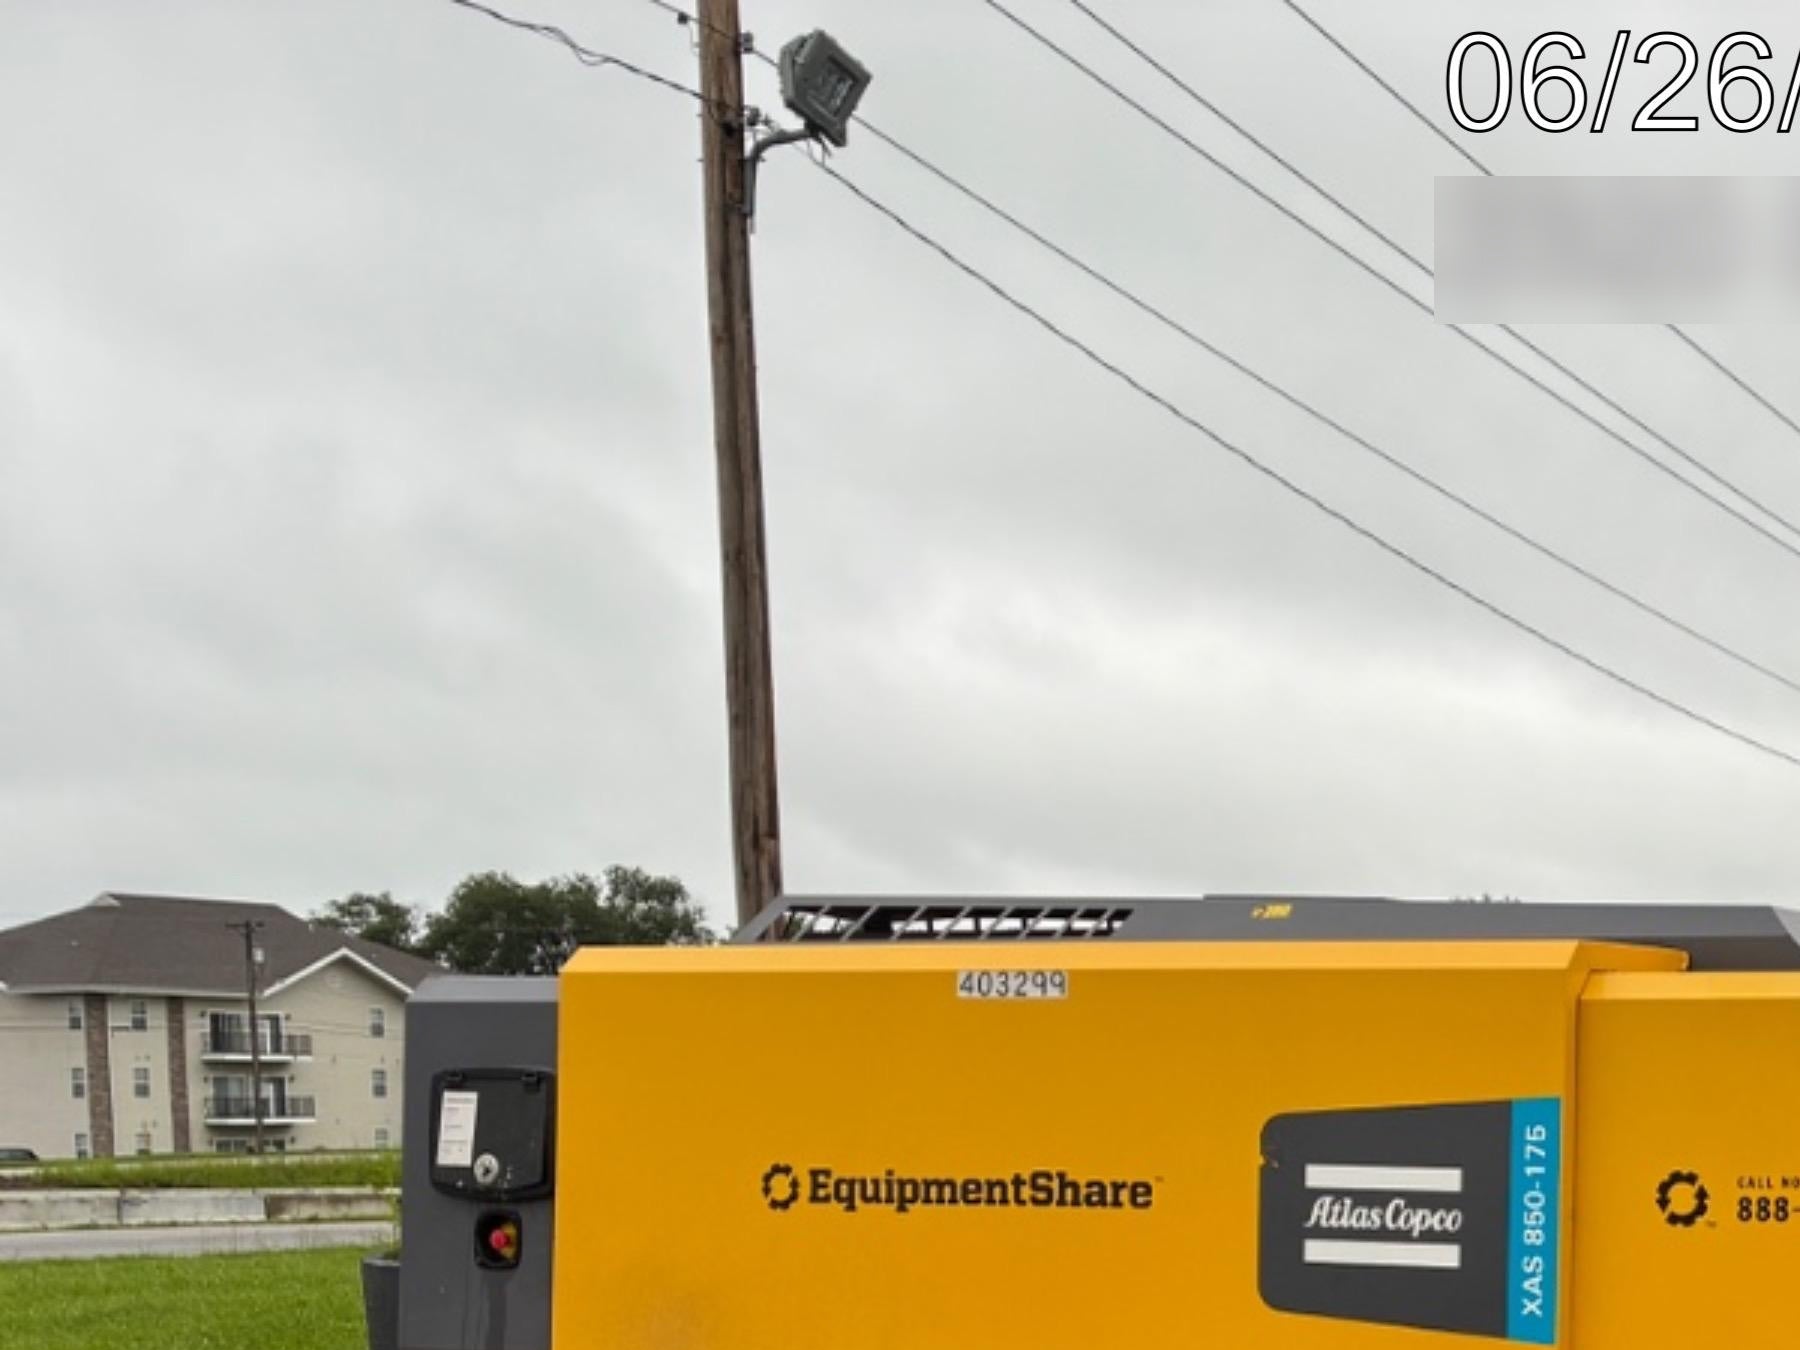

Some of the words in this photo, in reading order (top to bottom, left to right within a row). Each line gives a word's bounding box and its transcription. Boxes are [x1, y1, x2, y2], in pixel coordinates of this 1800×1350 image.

[959, 970, 1067, 998] 403299
[807, 1168, 1154, 1214] EquipmentShare
[1522, 1124, 1547, 1246] 850-175
[1736, 1175, 1774, 1190] CALL
[1304, 1195, 1384, 1230] Atlas
[1384, 1196, 1463, 1238] Copco
[1521, 1255, 1545, 1318] XAS
